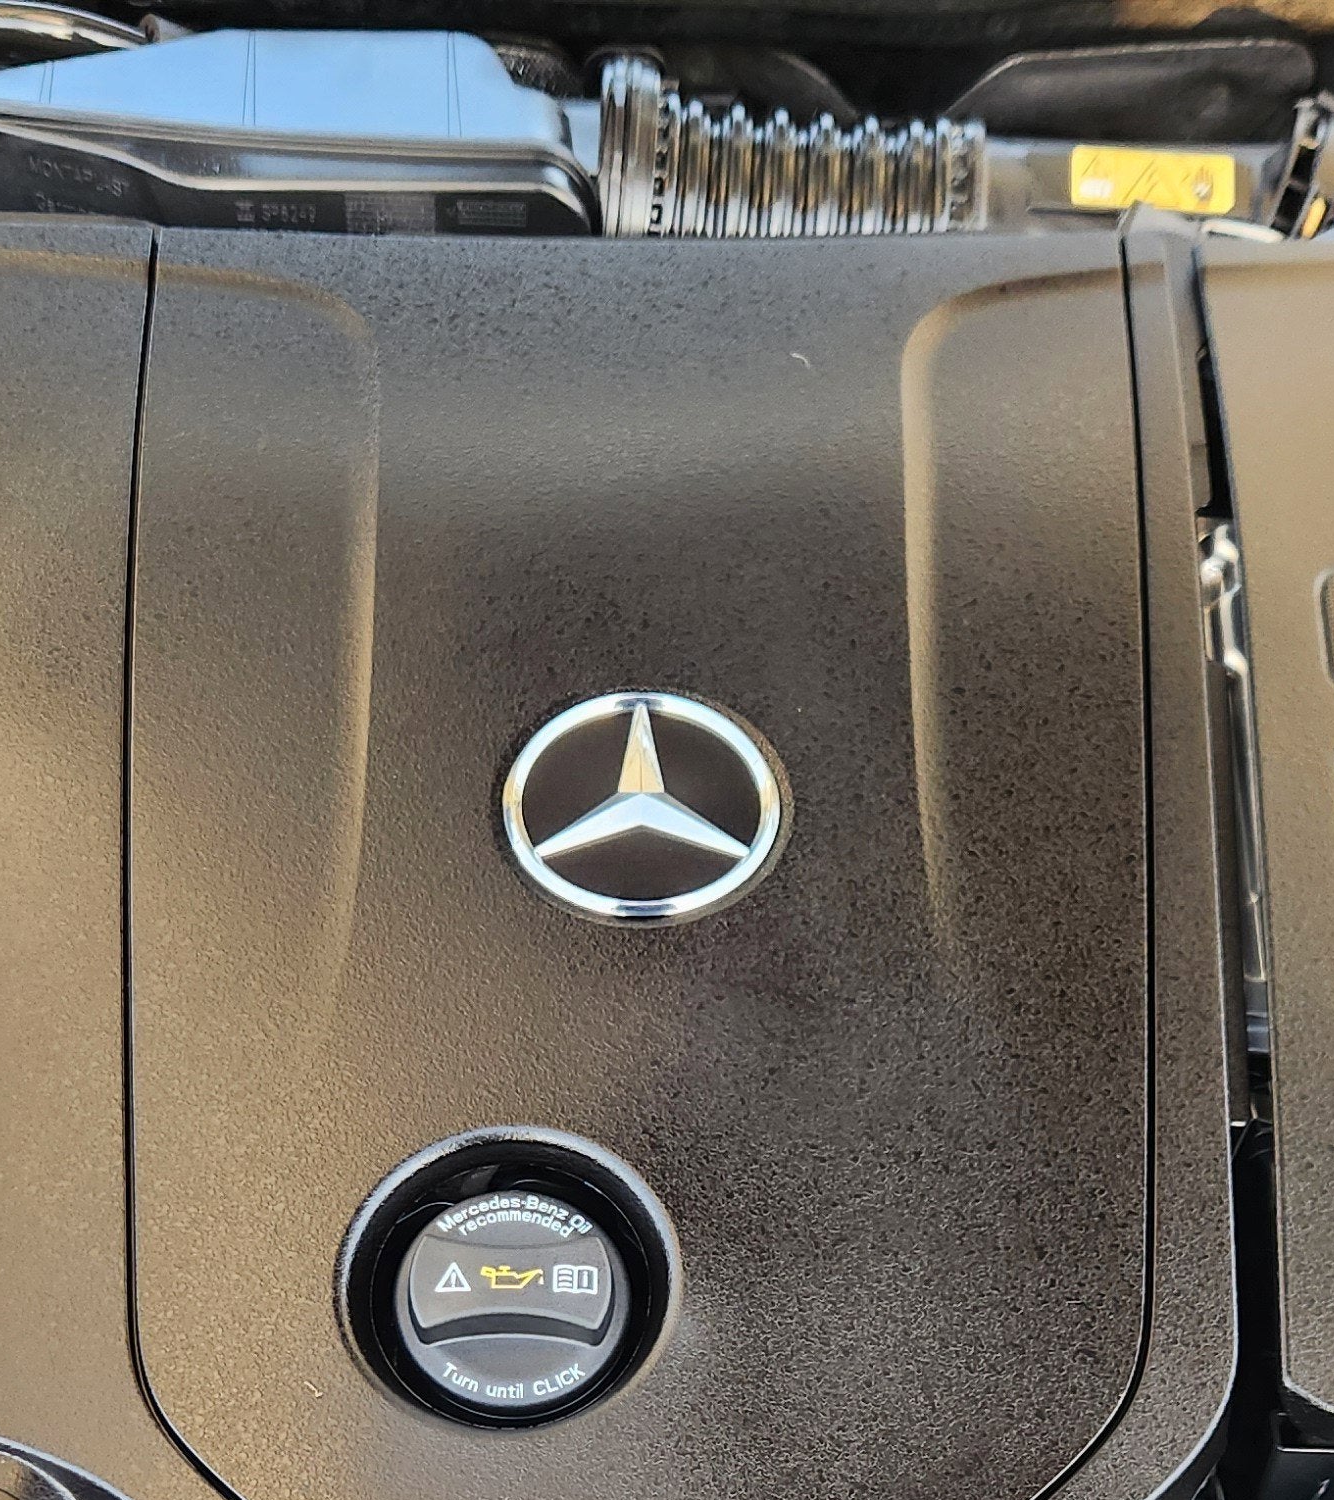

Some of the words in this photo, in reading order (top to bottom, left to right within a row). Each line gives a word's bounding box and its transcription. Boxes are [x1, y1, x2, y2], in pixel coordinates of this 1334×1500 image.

[435, 1193, 569, 1233] Mercedes-Benz
[569, 1214, 594, 1235] Oil
[458, 1208, 575, 1239] recommended
[442, 1362, 479, 1393] Turn
[485, 1382, 524, 1399] until
[533, 1362, 586, 1396] CLICK
